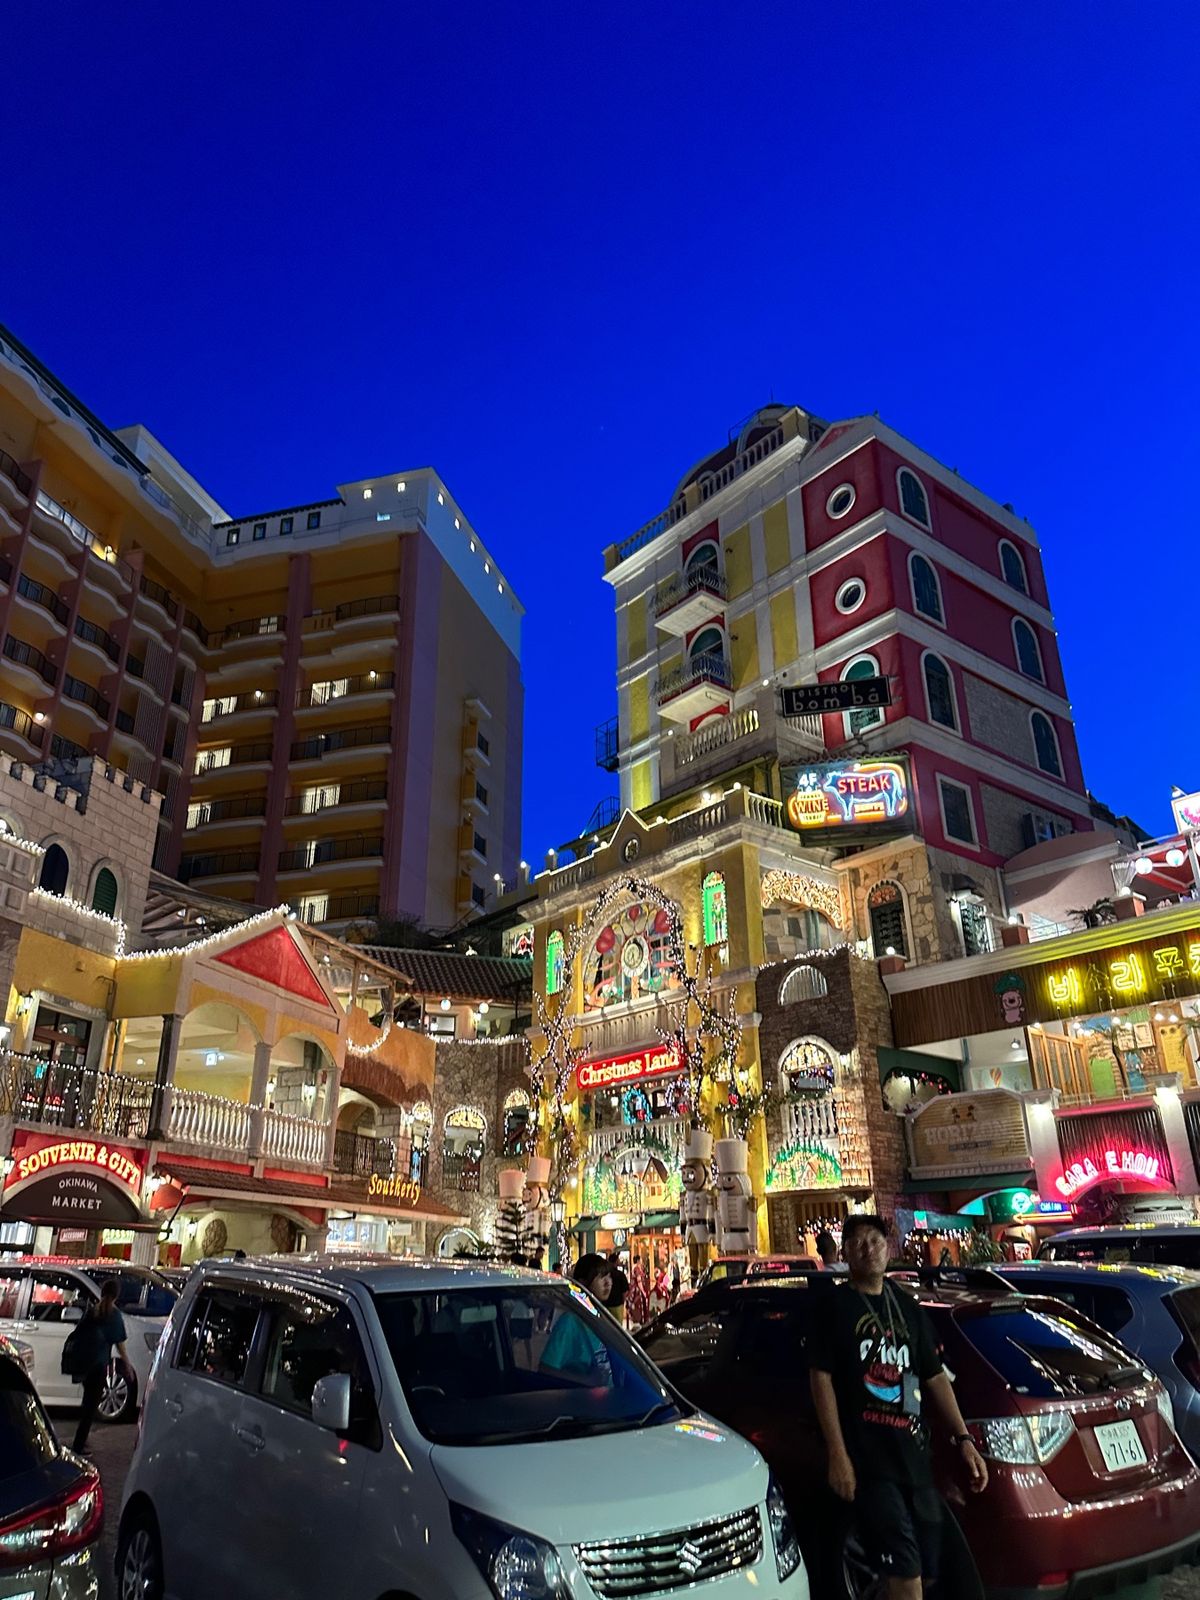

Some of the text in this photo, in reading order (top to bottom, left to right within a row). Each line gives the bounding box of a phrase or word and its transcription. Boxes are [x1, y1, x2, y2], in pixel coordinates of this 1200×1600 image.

[798, 683, 849, 698] BISTRO
[798, 772, 818, 787] 4F
[837, 775, 892, 794] STEAK
[795, 798, 830, 814] WINE
[579, 1049, 680, 1086] Christmas Land
[18, 1141, 142, 1185] SOUVENIR & GIFT
[58, 1177, 98, 1193] OKINAWA
[368, 1173, 421, 1206] Southerly
[52, 1196, 102, 1210] MARKET
